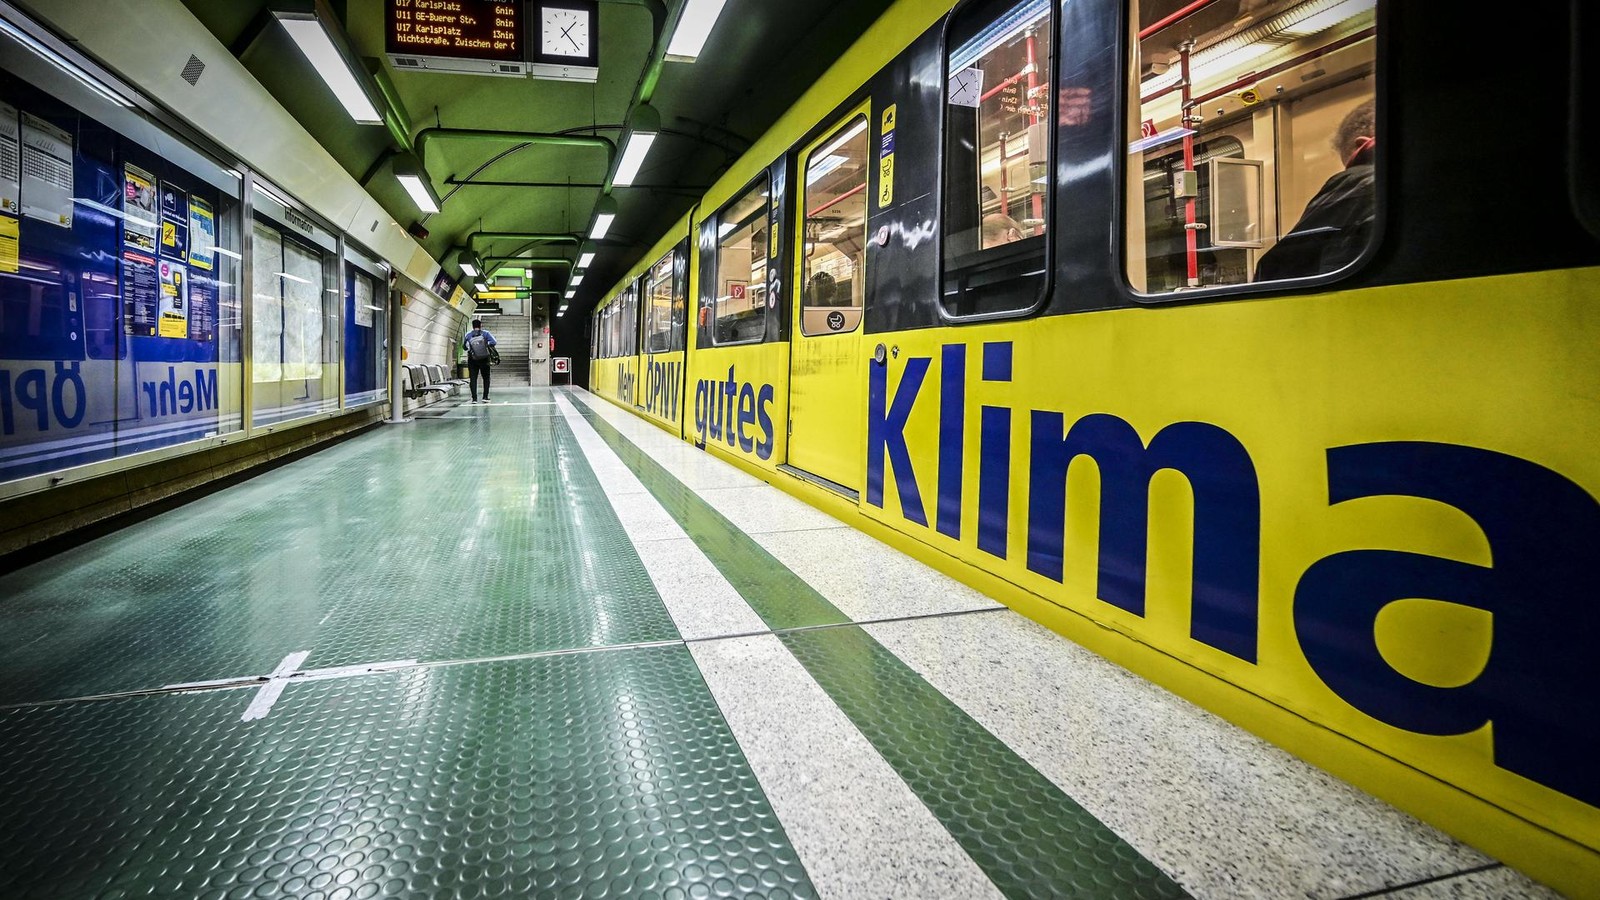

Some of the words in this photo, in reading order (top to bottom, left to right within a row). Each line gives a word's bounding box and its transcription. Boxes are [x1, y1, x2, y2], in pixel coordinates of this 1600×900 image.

[415, 0, 461, 11] Karlsplatz
[495, 5, 514, 16] 6min
[396, 10, 411, 20] U11
[460, 15, 476, 25] Str.
[495, 18, 514, 28] 8min
[396, 22, 411, 32] U17
[415, 24, 461, 36] Karlsplatz
[493, 30, 514, 40] 13min
[454, 37, 491, 48] Zwischen
[493, 40, 508, 49] der
[284, 206, 314, 236] Information
[618, 360, 634, 405] Mehr
[646, 355, 681, 422] ÖPNV
[695, 364, 773, 460] gutes
[865, 341, 1600, 809] Klima
